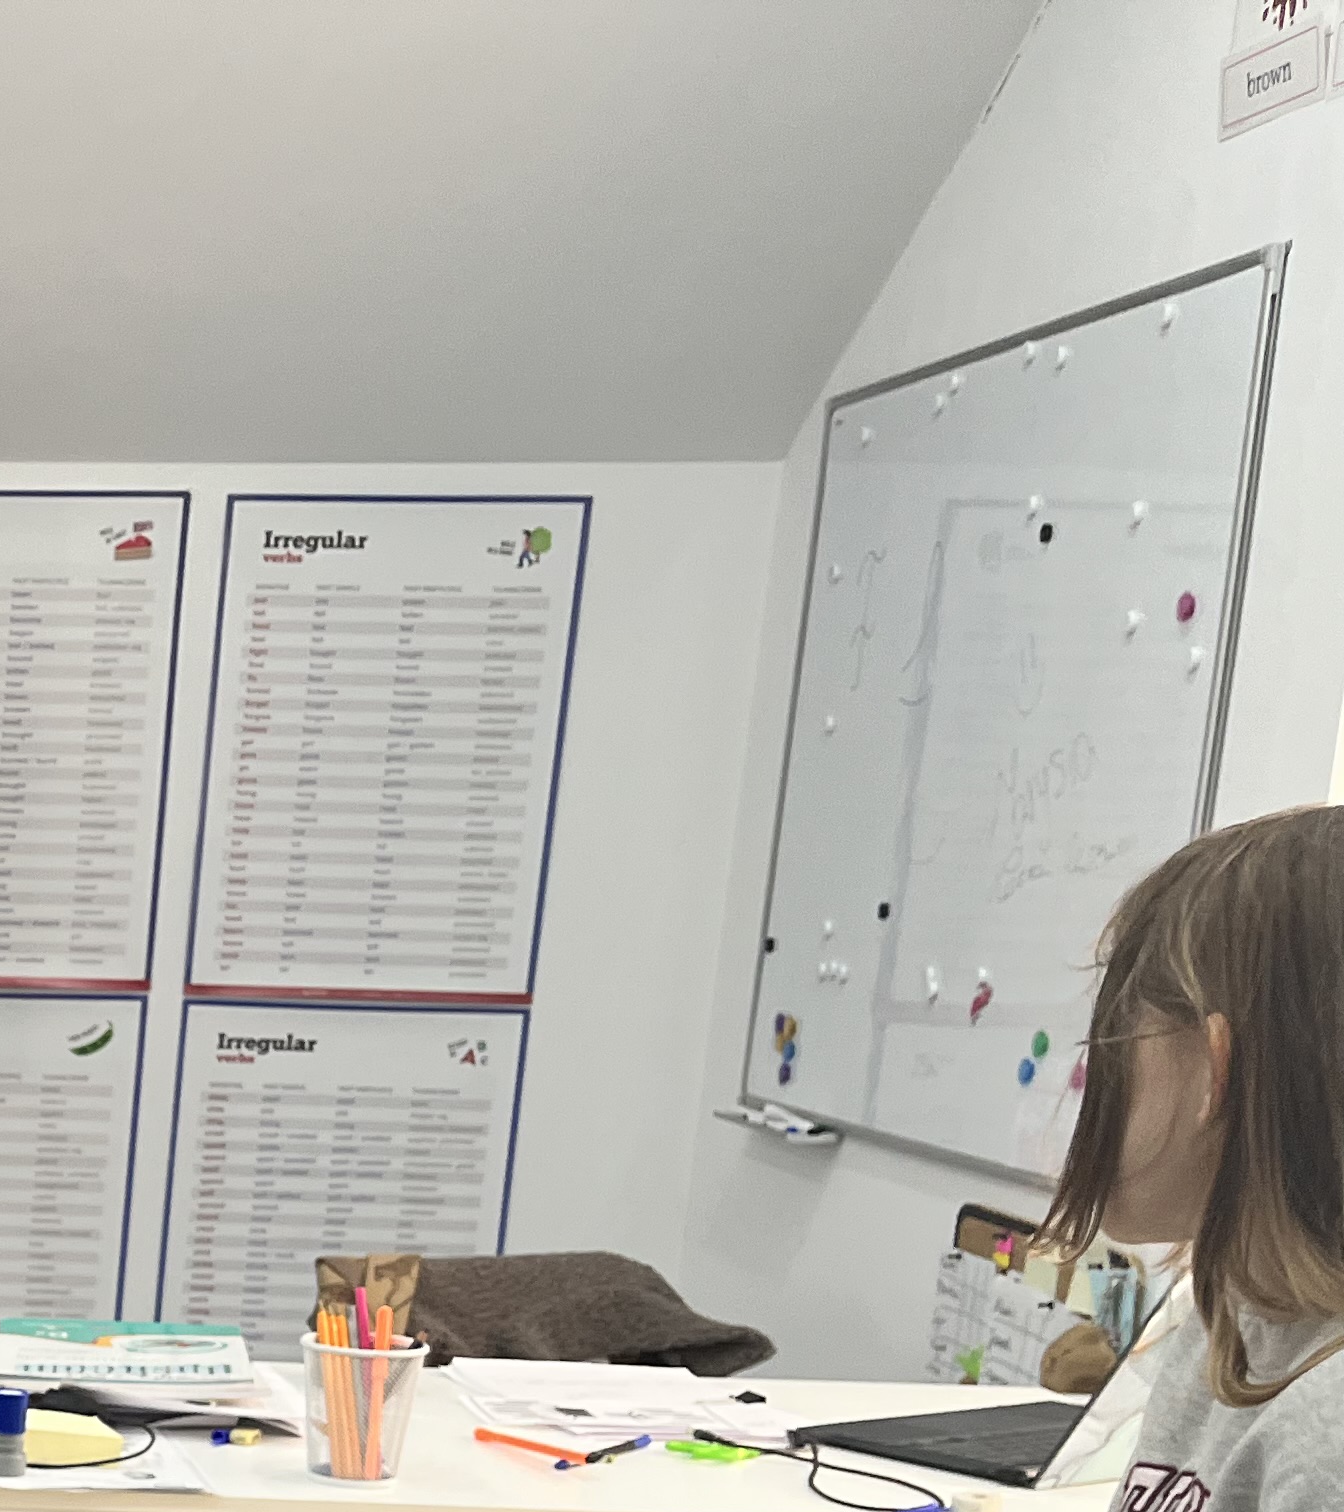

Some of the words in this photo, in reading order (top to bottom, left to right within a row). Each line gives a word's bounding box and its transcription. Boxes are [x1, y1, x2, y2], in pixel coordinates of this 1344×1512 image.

[1247, 62, 1292, 98] brown
[263, 530, 368, 553] Irregular
[263, 552, 303, 563] verbs
[217, 1032, 318, 1055] Irregular
[216, 1053, 255, 1064] verbs
